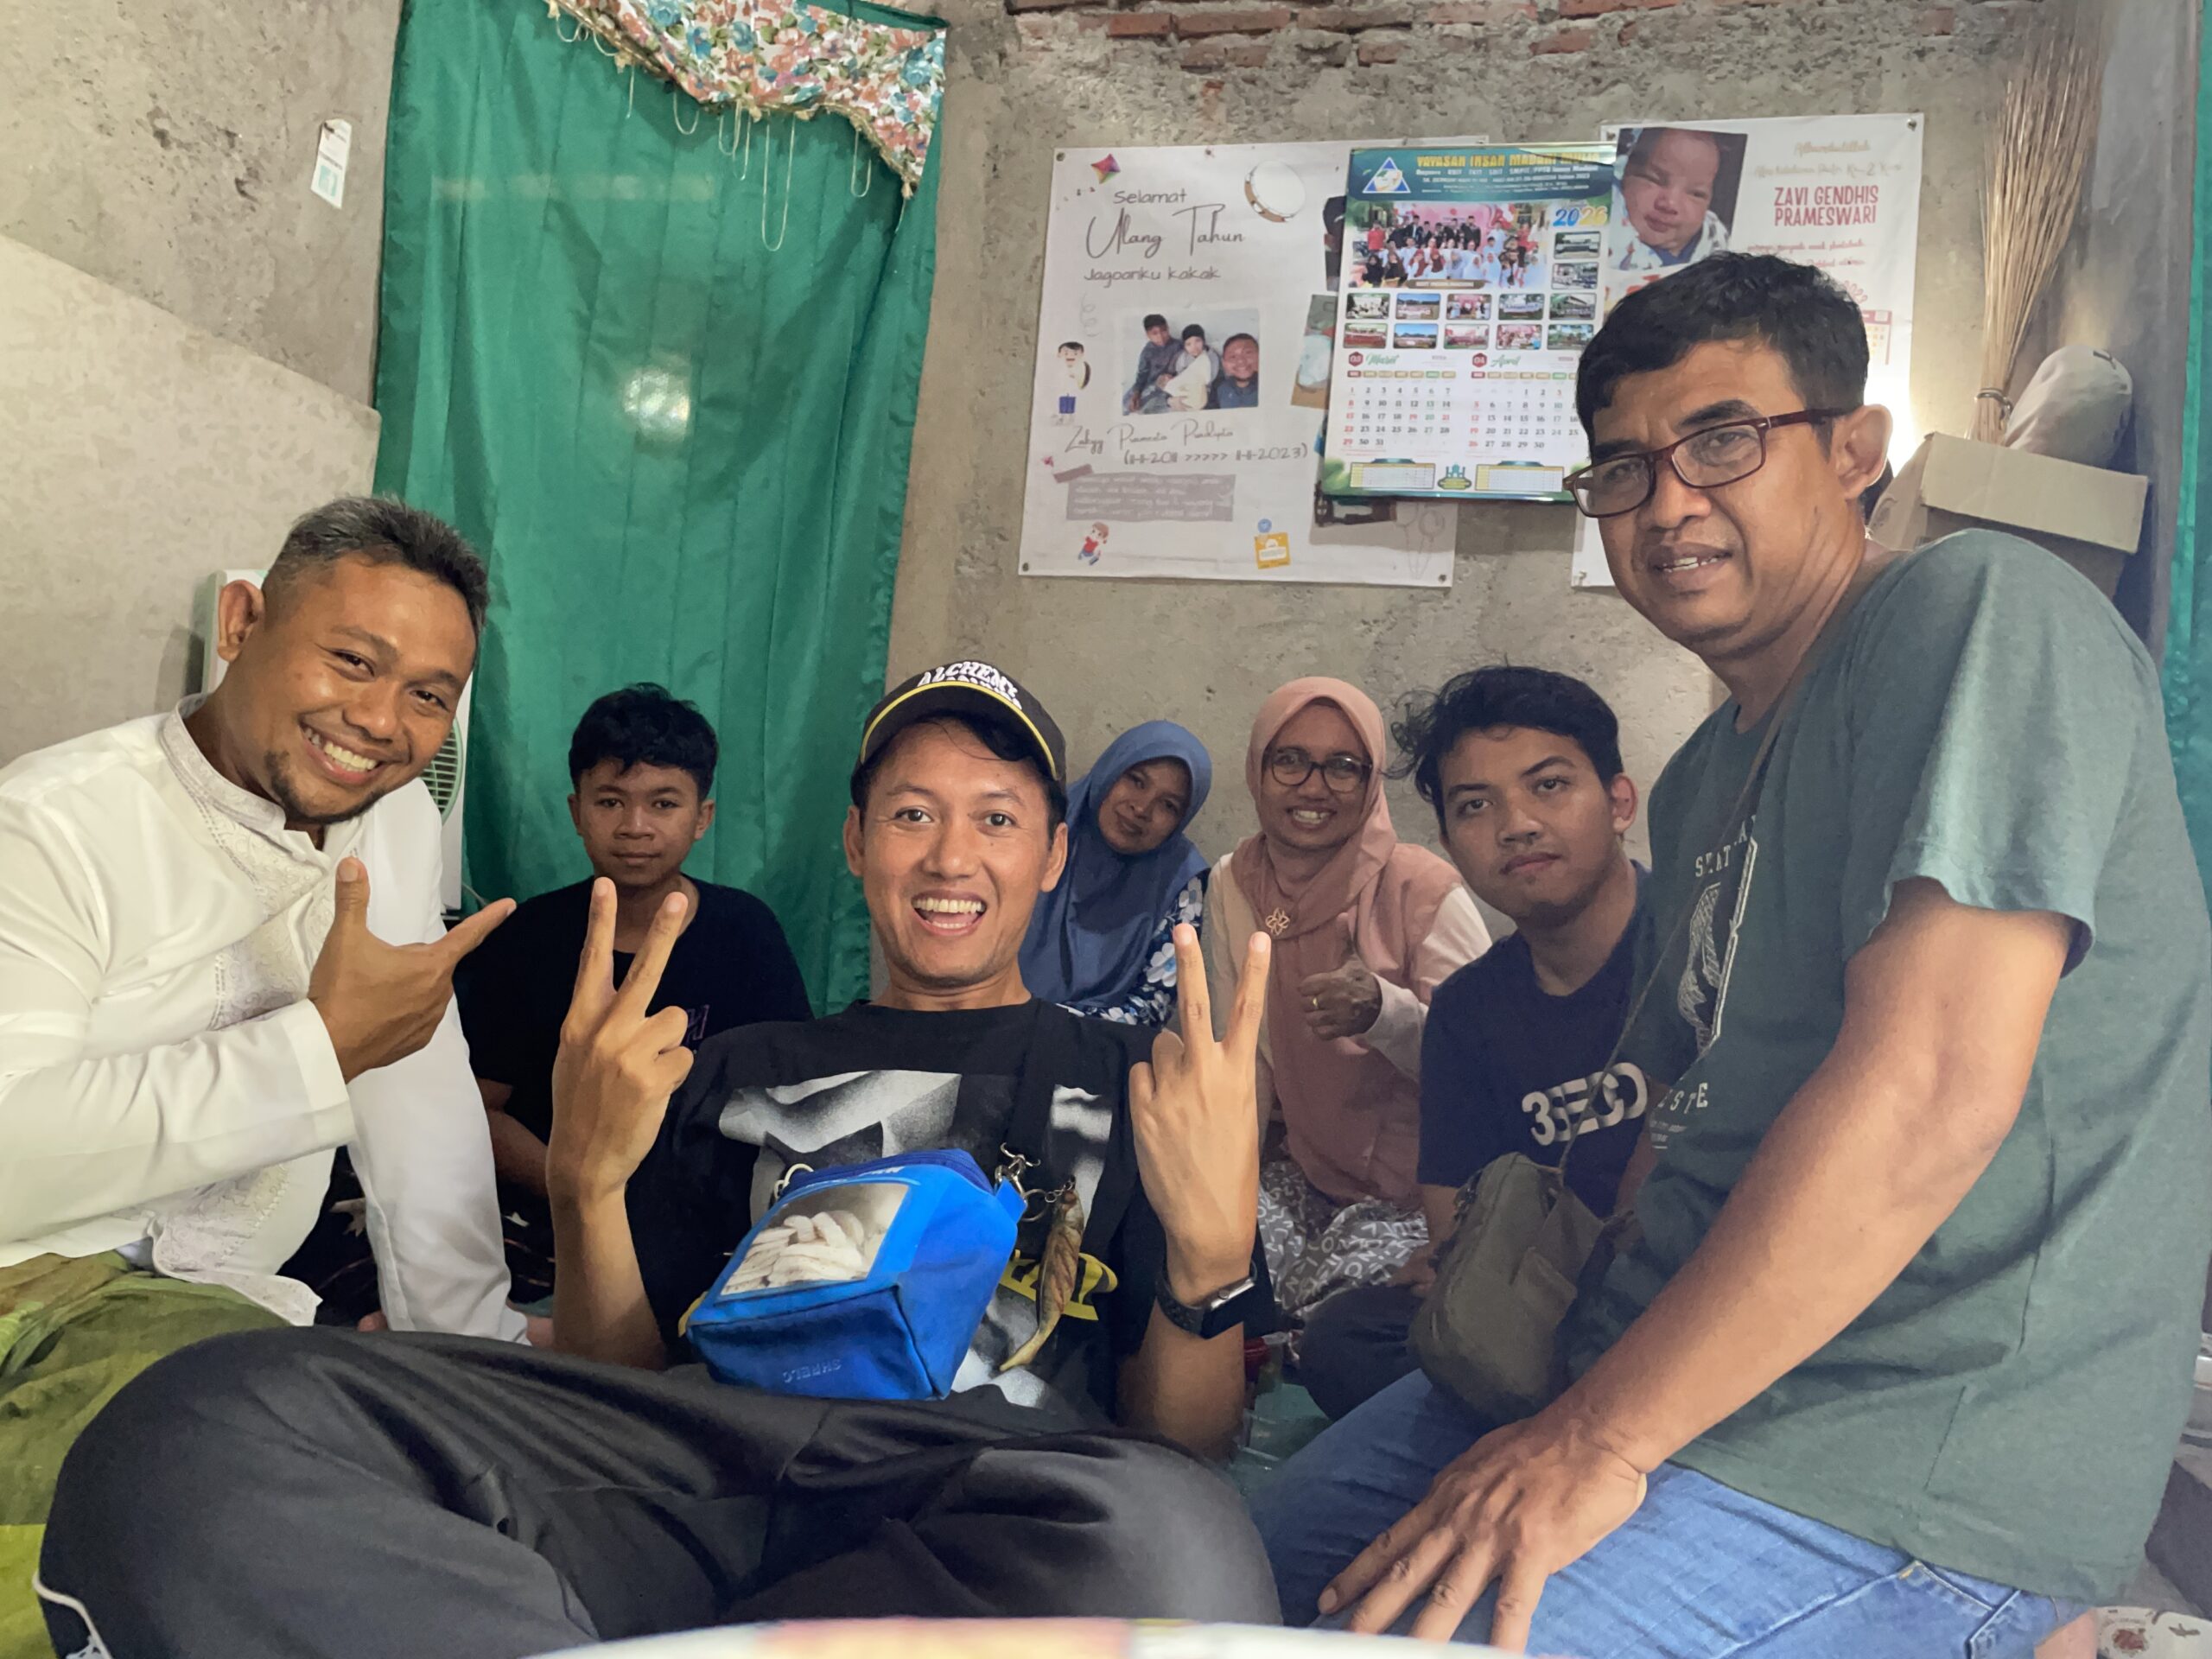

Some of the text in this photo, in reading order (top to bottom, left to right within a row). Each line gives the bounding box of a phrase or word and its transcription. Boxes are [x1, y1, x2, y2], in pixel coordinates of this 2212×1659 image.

[1417, 156, 1465, 167] YAYASAN
[1470, 155, 1505, 167] INSAN
[1113, 188, 1187, 204] Selamat
[1774, 185, 1879, 207] ZAVI GENDHIS
[1553, 207, 1608, 226] 2026
[1774, 205, 1876, 226] PRAMESWARI
[1086, 203, 1244, 259] Ulang Tahun
